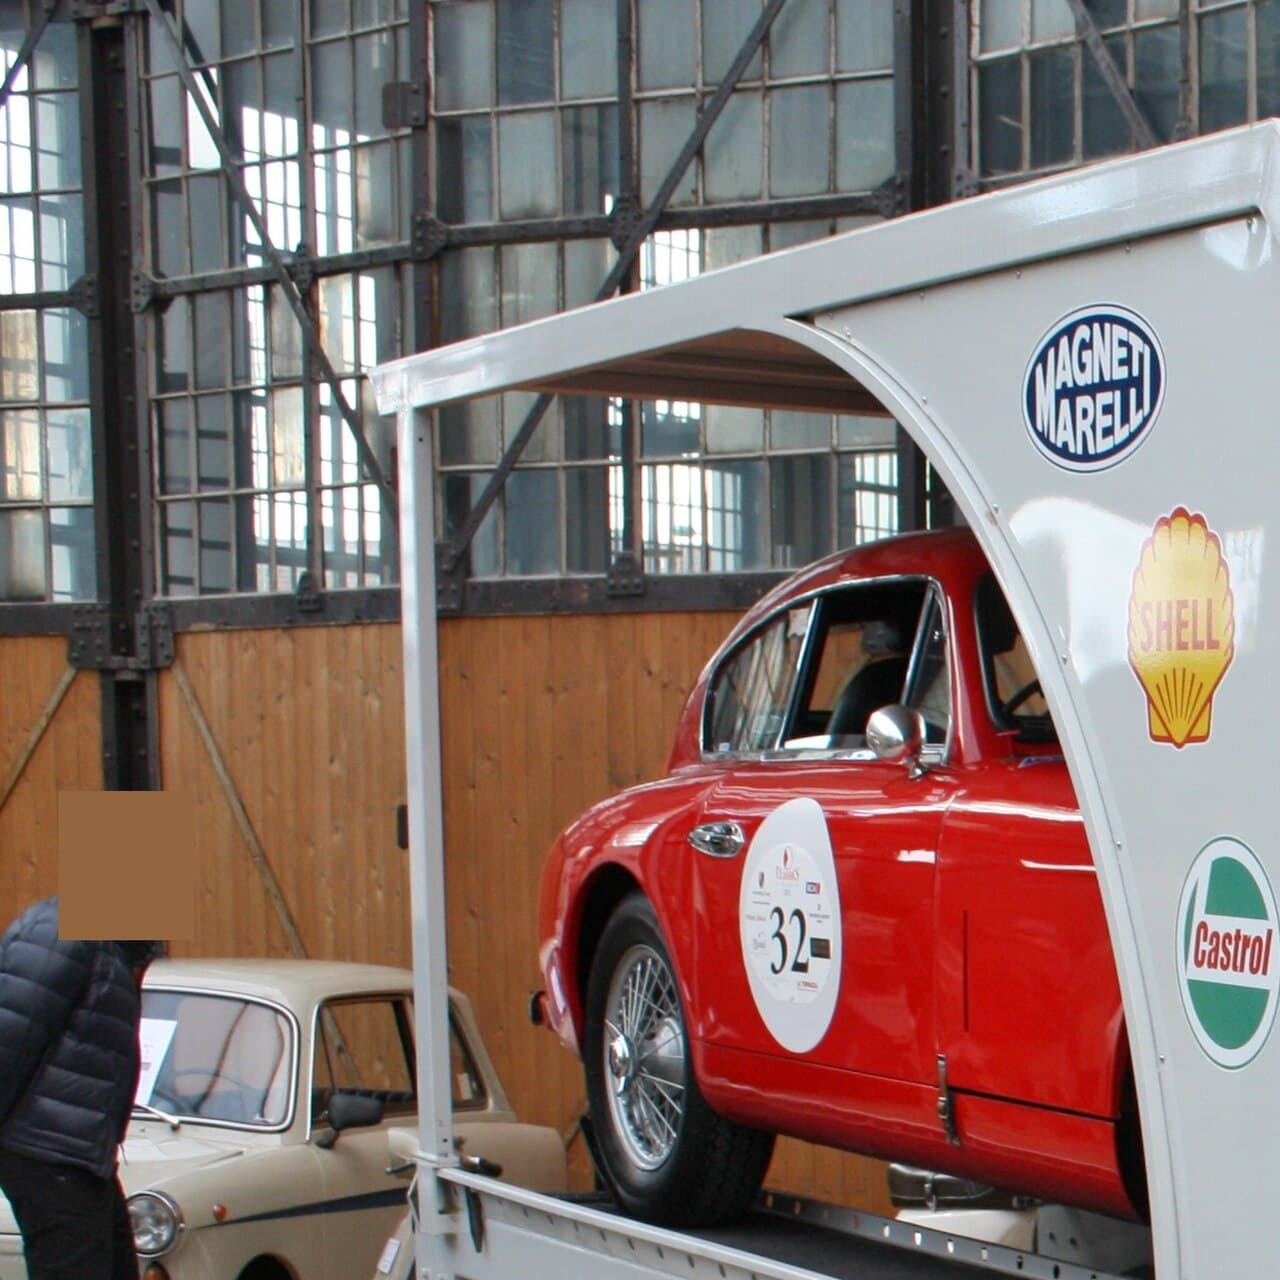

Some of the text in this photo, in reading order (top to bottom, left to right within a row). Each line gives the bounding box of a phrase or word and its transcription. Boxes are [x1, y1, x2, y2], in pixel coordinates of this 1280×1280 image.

[1035, 322, 1150, 392] MAGNETI
[1035, 386, 1150, 456] MARELLI
[1140, 597, 1220, 652] SHELL
[769, 906, 810, 975] 32
[1193, 920, 1273, 977] Castrol
